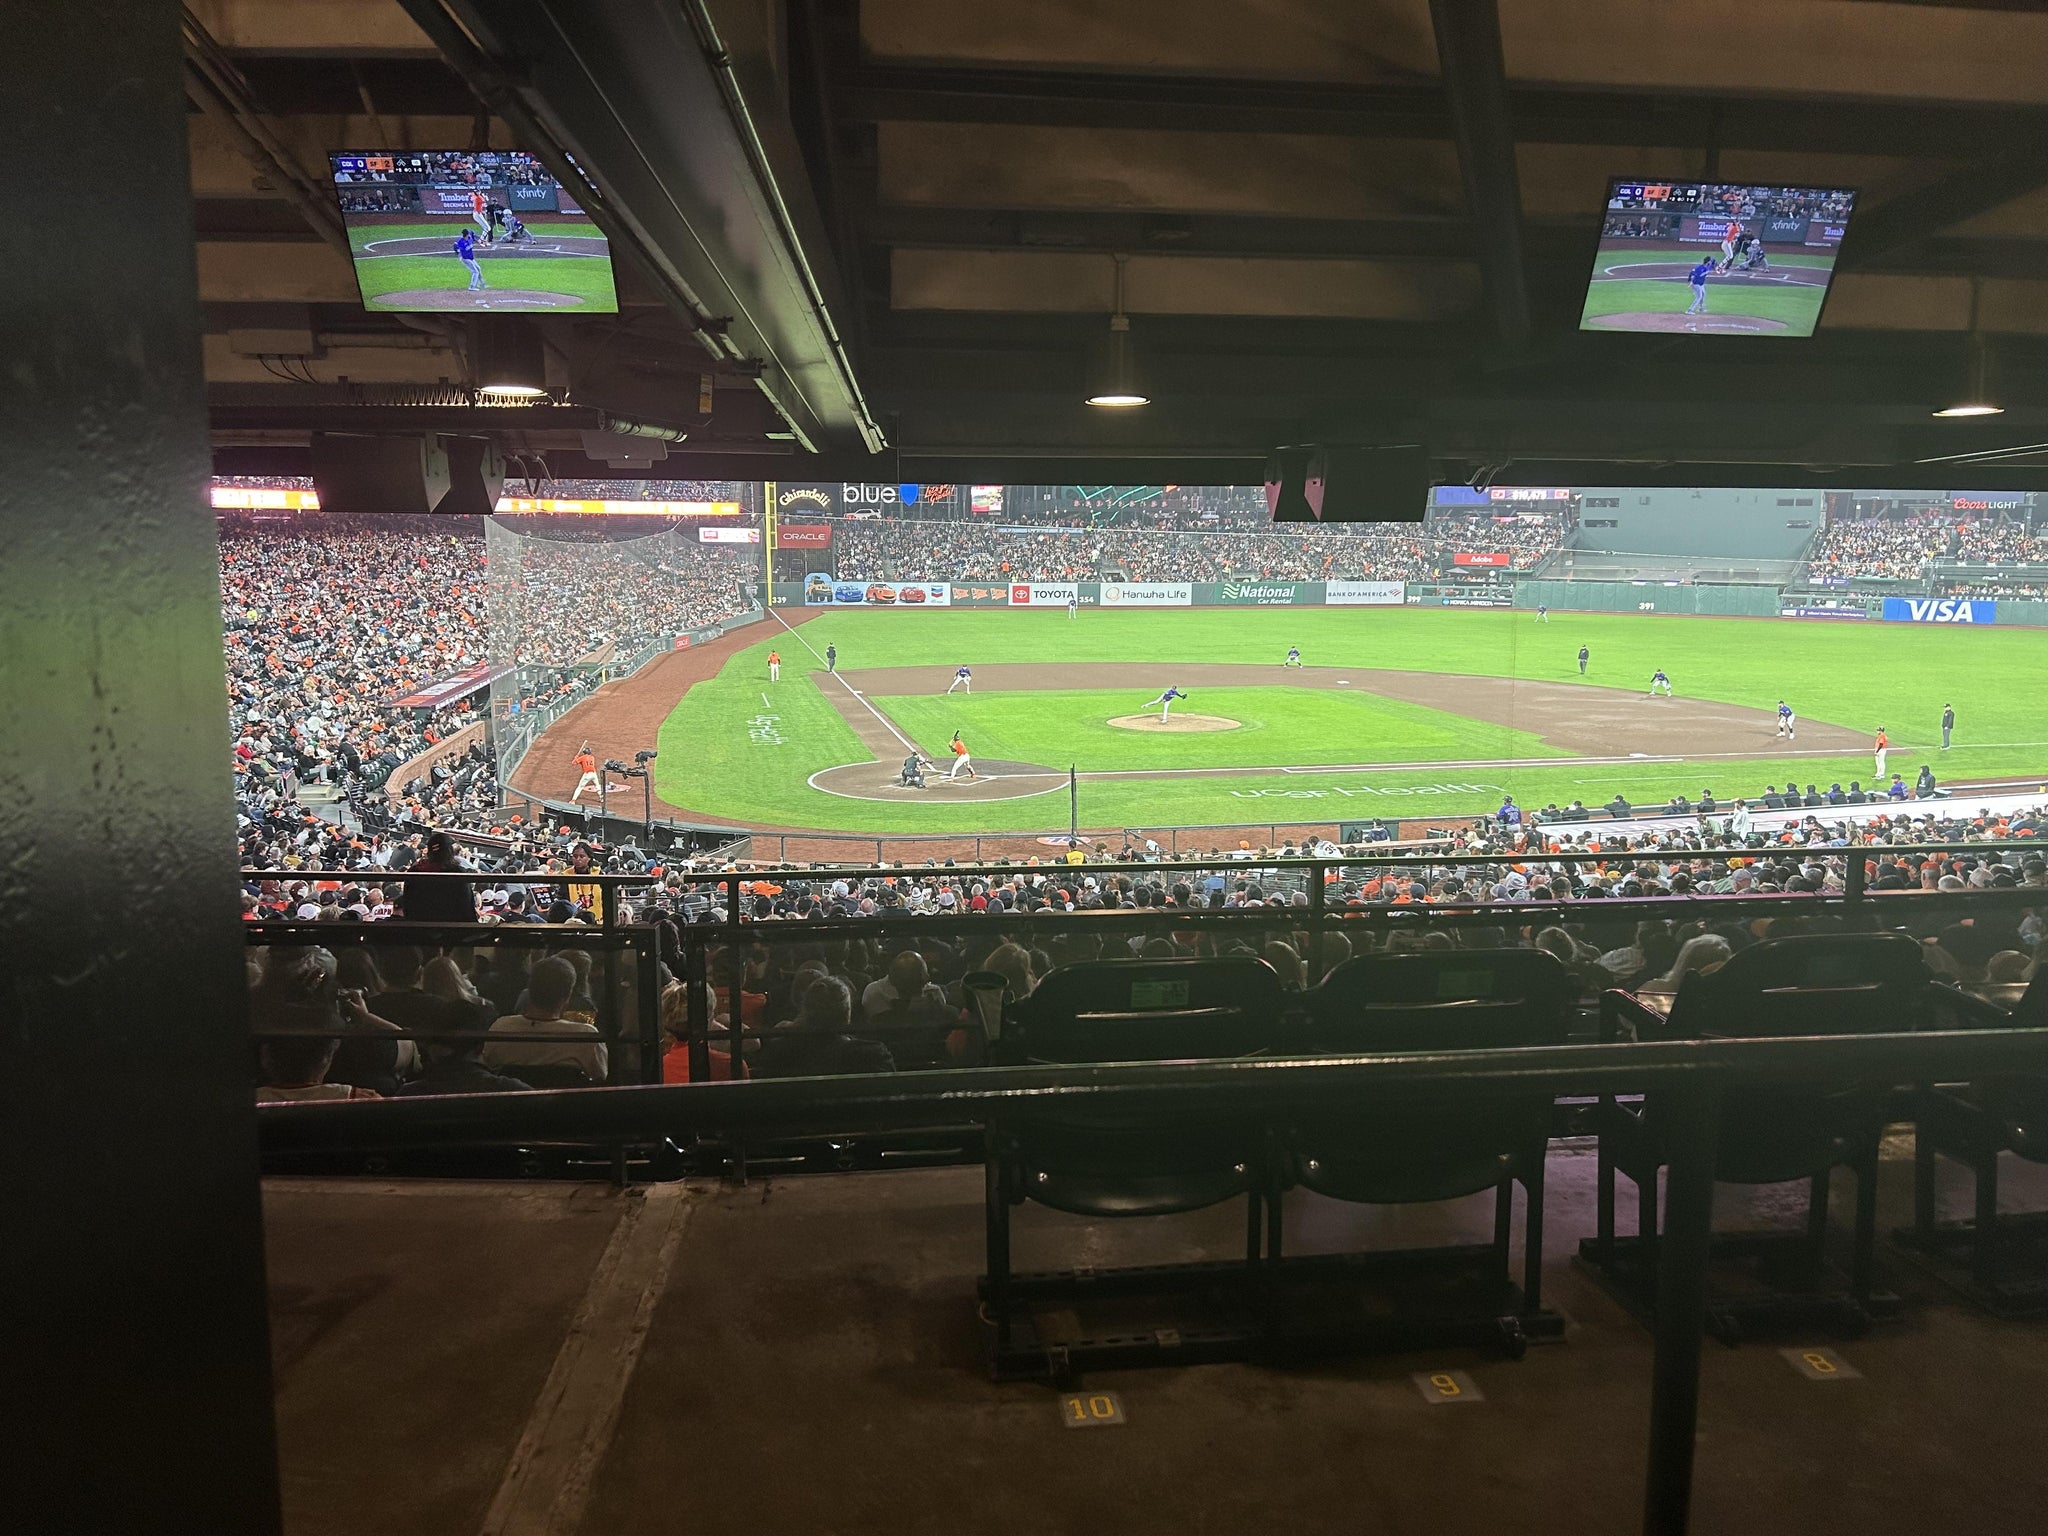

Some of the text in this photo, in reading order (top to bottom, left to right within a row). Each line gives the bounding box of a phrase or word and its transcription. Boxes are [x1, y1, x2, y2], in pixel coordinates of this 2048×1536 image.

[357, 160, 364, 168] 0
[517, 187, 546, 200] xfinity
[1635, 187, 1642, 195] 0
[1771, 219, 1799, 231] xfinity
[779, 488, 831, 507] Ghirardelli
[843, 482, 896, 504] blue
[1953, 497, 2018, 510] Coors LIGHT
[782, 533, 826, 541] ORACLE
[1470, 555, 1494, 563] Adobe
[1033, 590, 1075, 600] TOYOTA
[1122, 590, 1187, 599] Hanwha Life
[1238, 585, 1296, 598] National
[772, 596, 787, 604] 339
[1406, 595, 1421, 603] 399
[1639, 602, 1655, 610] 391
[1904, 599, 1973, 622] VISA
[1229, 782, 1505, 799] UCSF Health
[1803, 1352, 1838, 1373] 8
[1430, 1374, 1461, 1396] 9
[1069, 1395, 1115, 1420] 10
